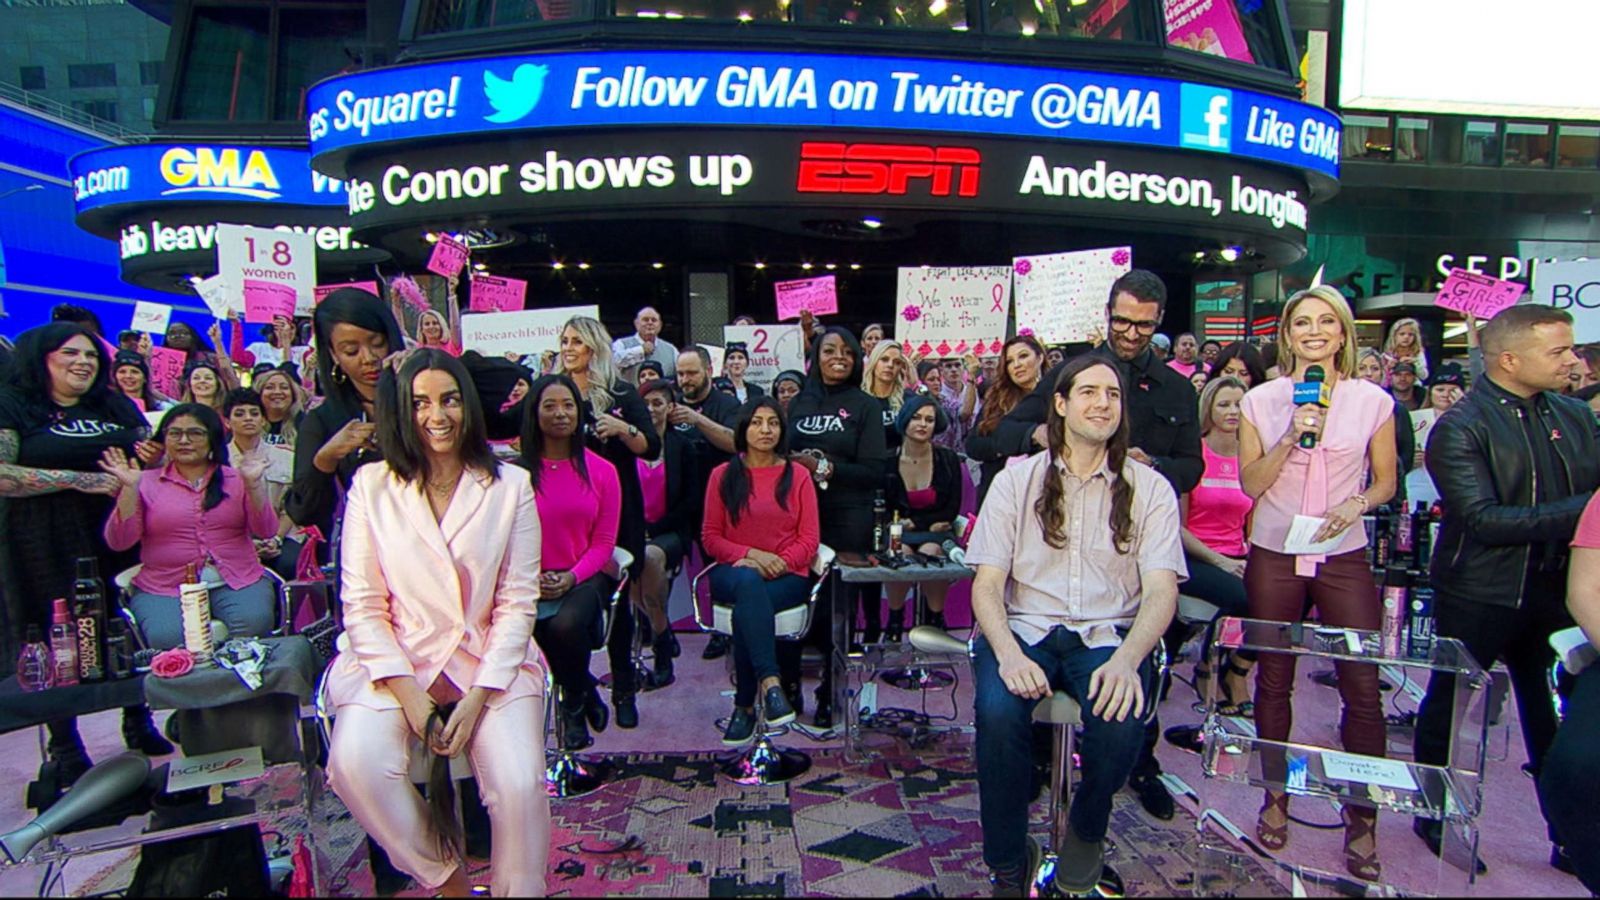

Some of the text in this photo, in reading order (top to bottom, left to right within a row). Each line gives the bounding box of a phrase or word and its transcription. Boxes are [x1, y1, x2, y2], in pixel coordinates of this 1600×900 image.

[334, 76, 461, 137] Square!
[570, 66, 1161, 130] Follow GMA on Twitter @GMA
[1245, 105, 1339, 165] Like GMA
[160, 147, 281, 189] GMA
[382, 164, 509, 205] Conor
[520, 151, 675, 194] shows
[690, 154, 753, 195] up
[797, 141, 981, 197] ESPN
[1019, 156, 1221, 216] Anderson,
[244, 237, 255, 263] 1
[272, 240, 292, 266] 8
[242, 267, 297, 281] women
[918, 287, 942, 309] We
[1447, 295, 1498, 318] RULE
[1452, 281, 1506, 306] GIRLS
[922, 312, 951, 330] Pink
[753, 328, 769, 353] 2
[804, 415, 845, 431] ULTA
[78, 617, 96, 638] 28
